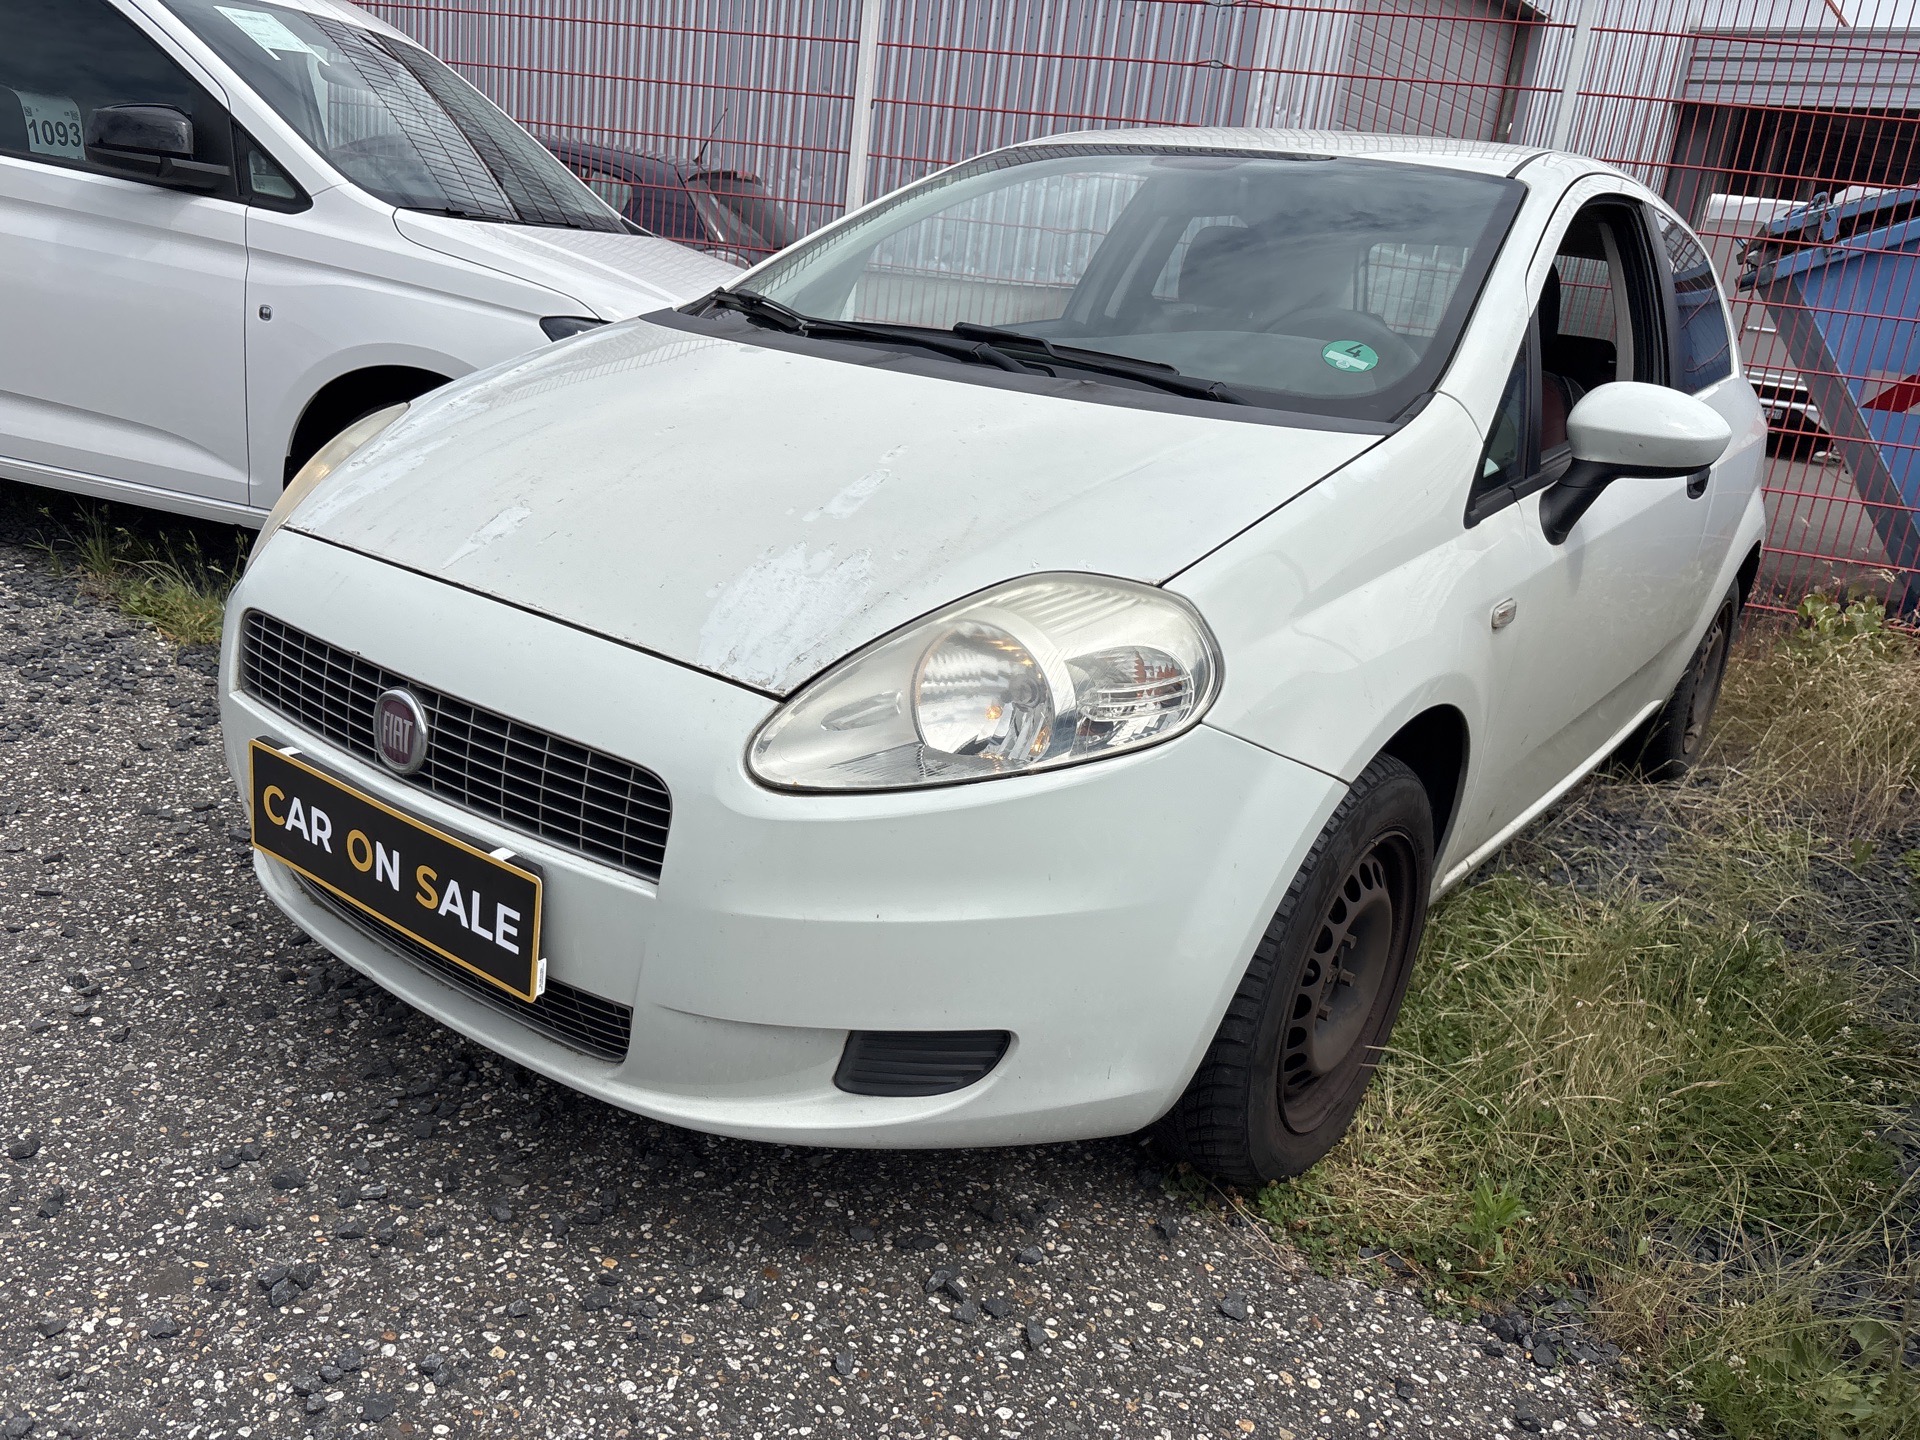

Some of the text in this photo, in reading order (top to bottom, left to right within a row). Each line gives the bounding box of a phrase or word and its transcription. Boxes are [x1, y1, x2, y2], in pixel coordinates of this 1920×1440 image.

[28, 119, 81, 147] 1093
[1345, 344, 1364, 358] 4
[383, 711, 413, 754] FIAT
[263, 785, 521, 955] CAR ON SALE
